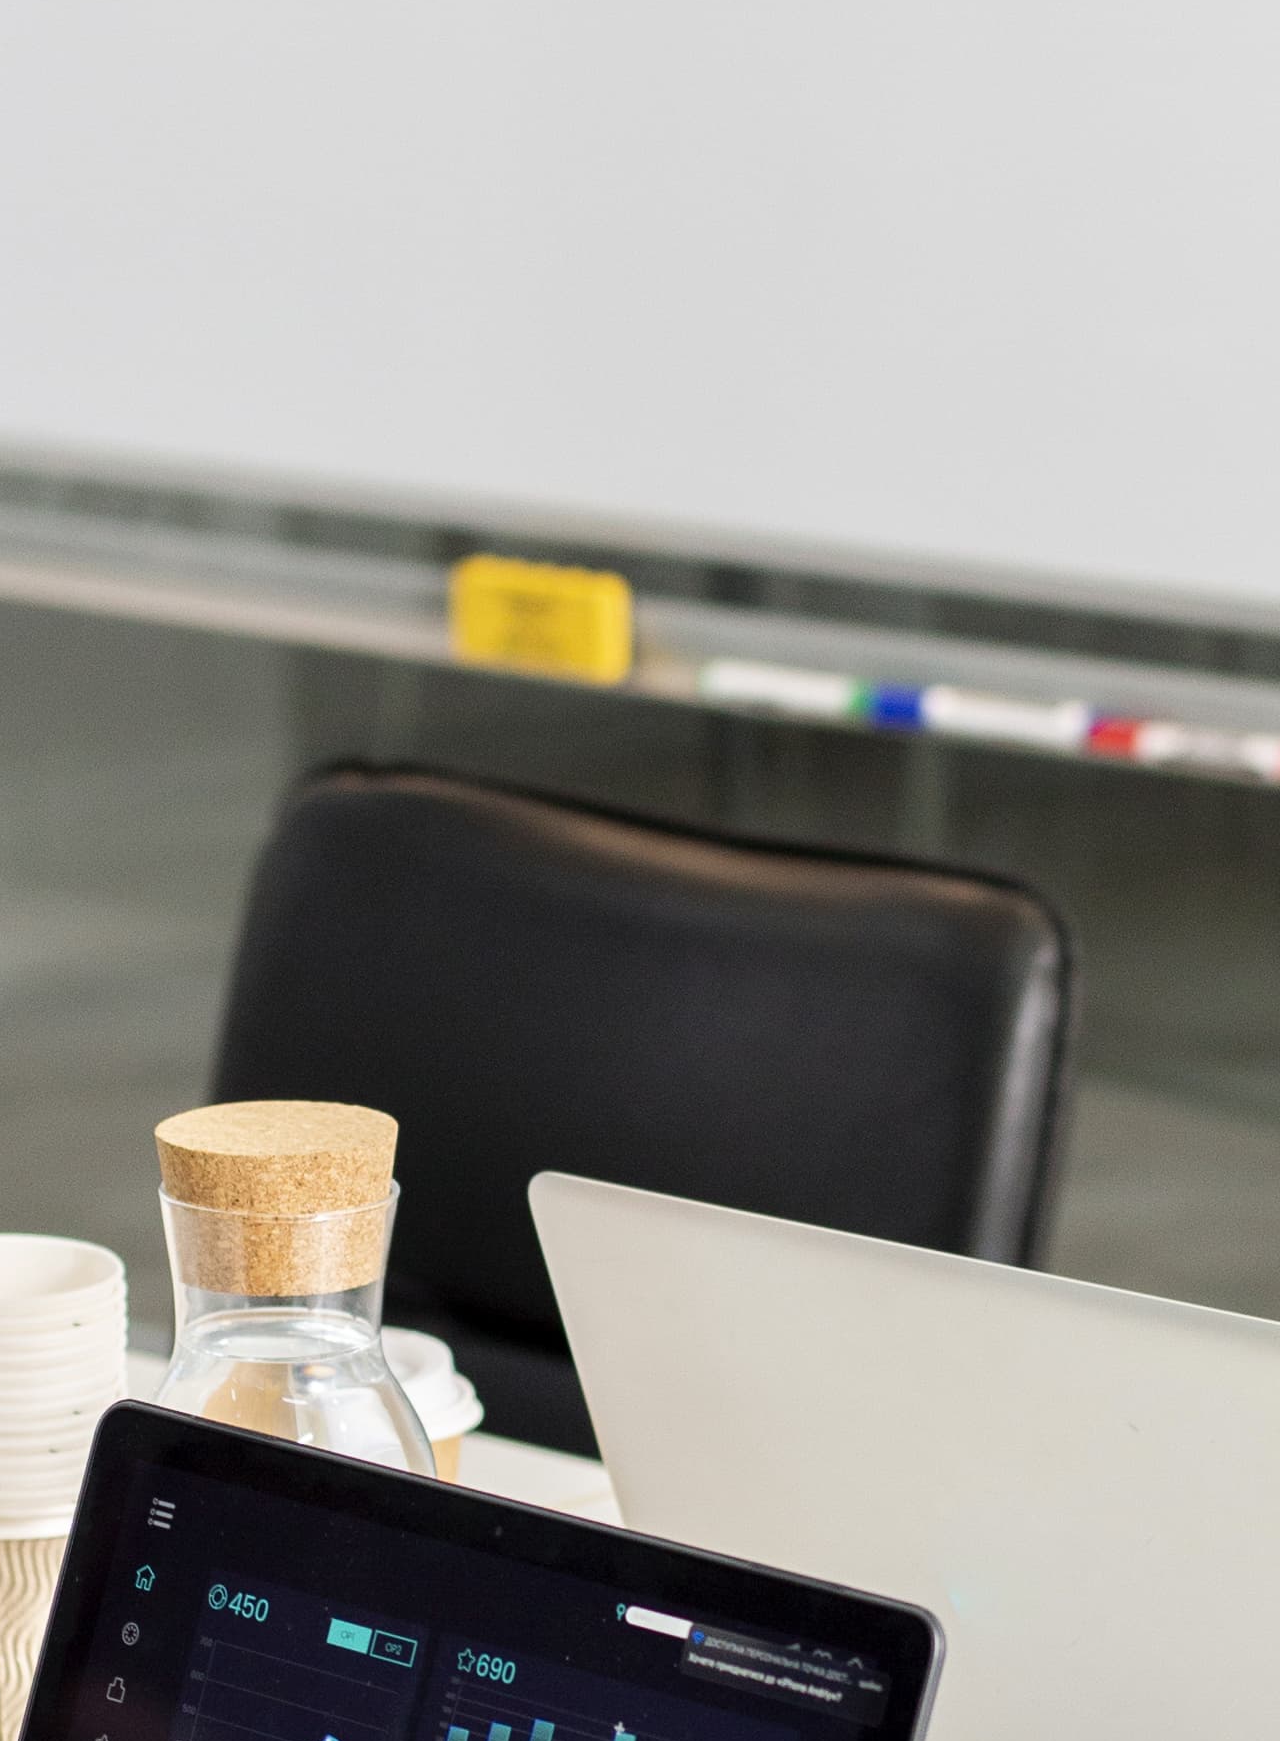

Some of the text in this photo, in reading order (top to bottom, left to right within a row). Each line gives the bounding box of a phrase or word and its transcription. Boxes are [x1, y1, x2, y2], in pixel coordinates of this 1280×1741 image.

[228, 1591, 269, 1622] 450
[384, 1641, 403, 1656] OP2
[475, 1653, 517, 1685] 690
